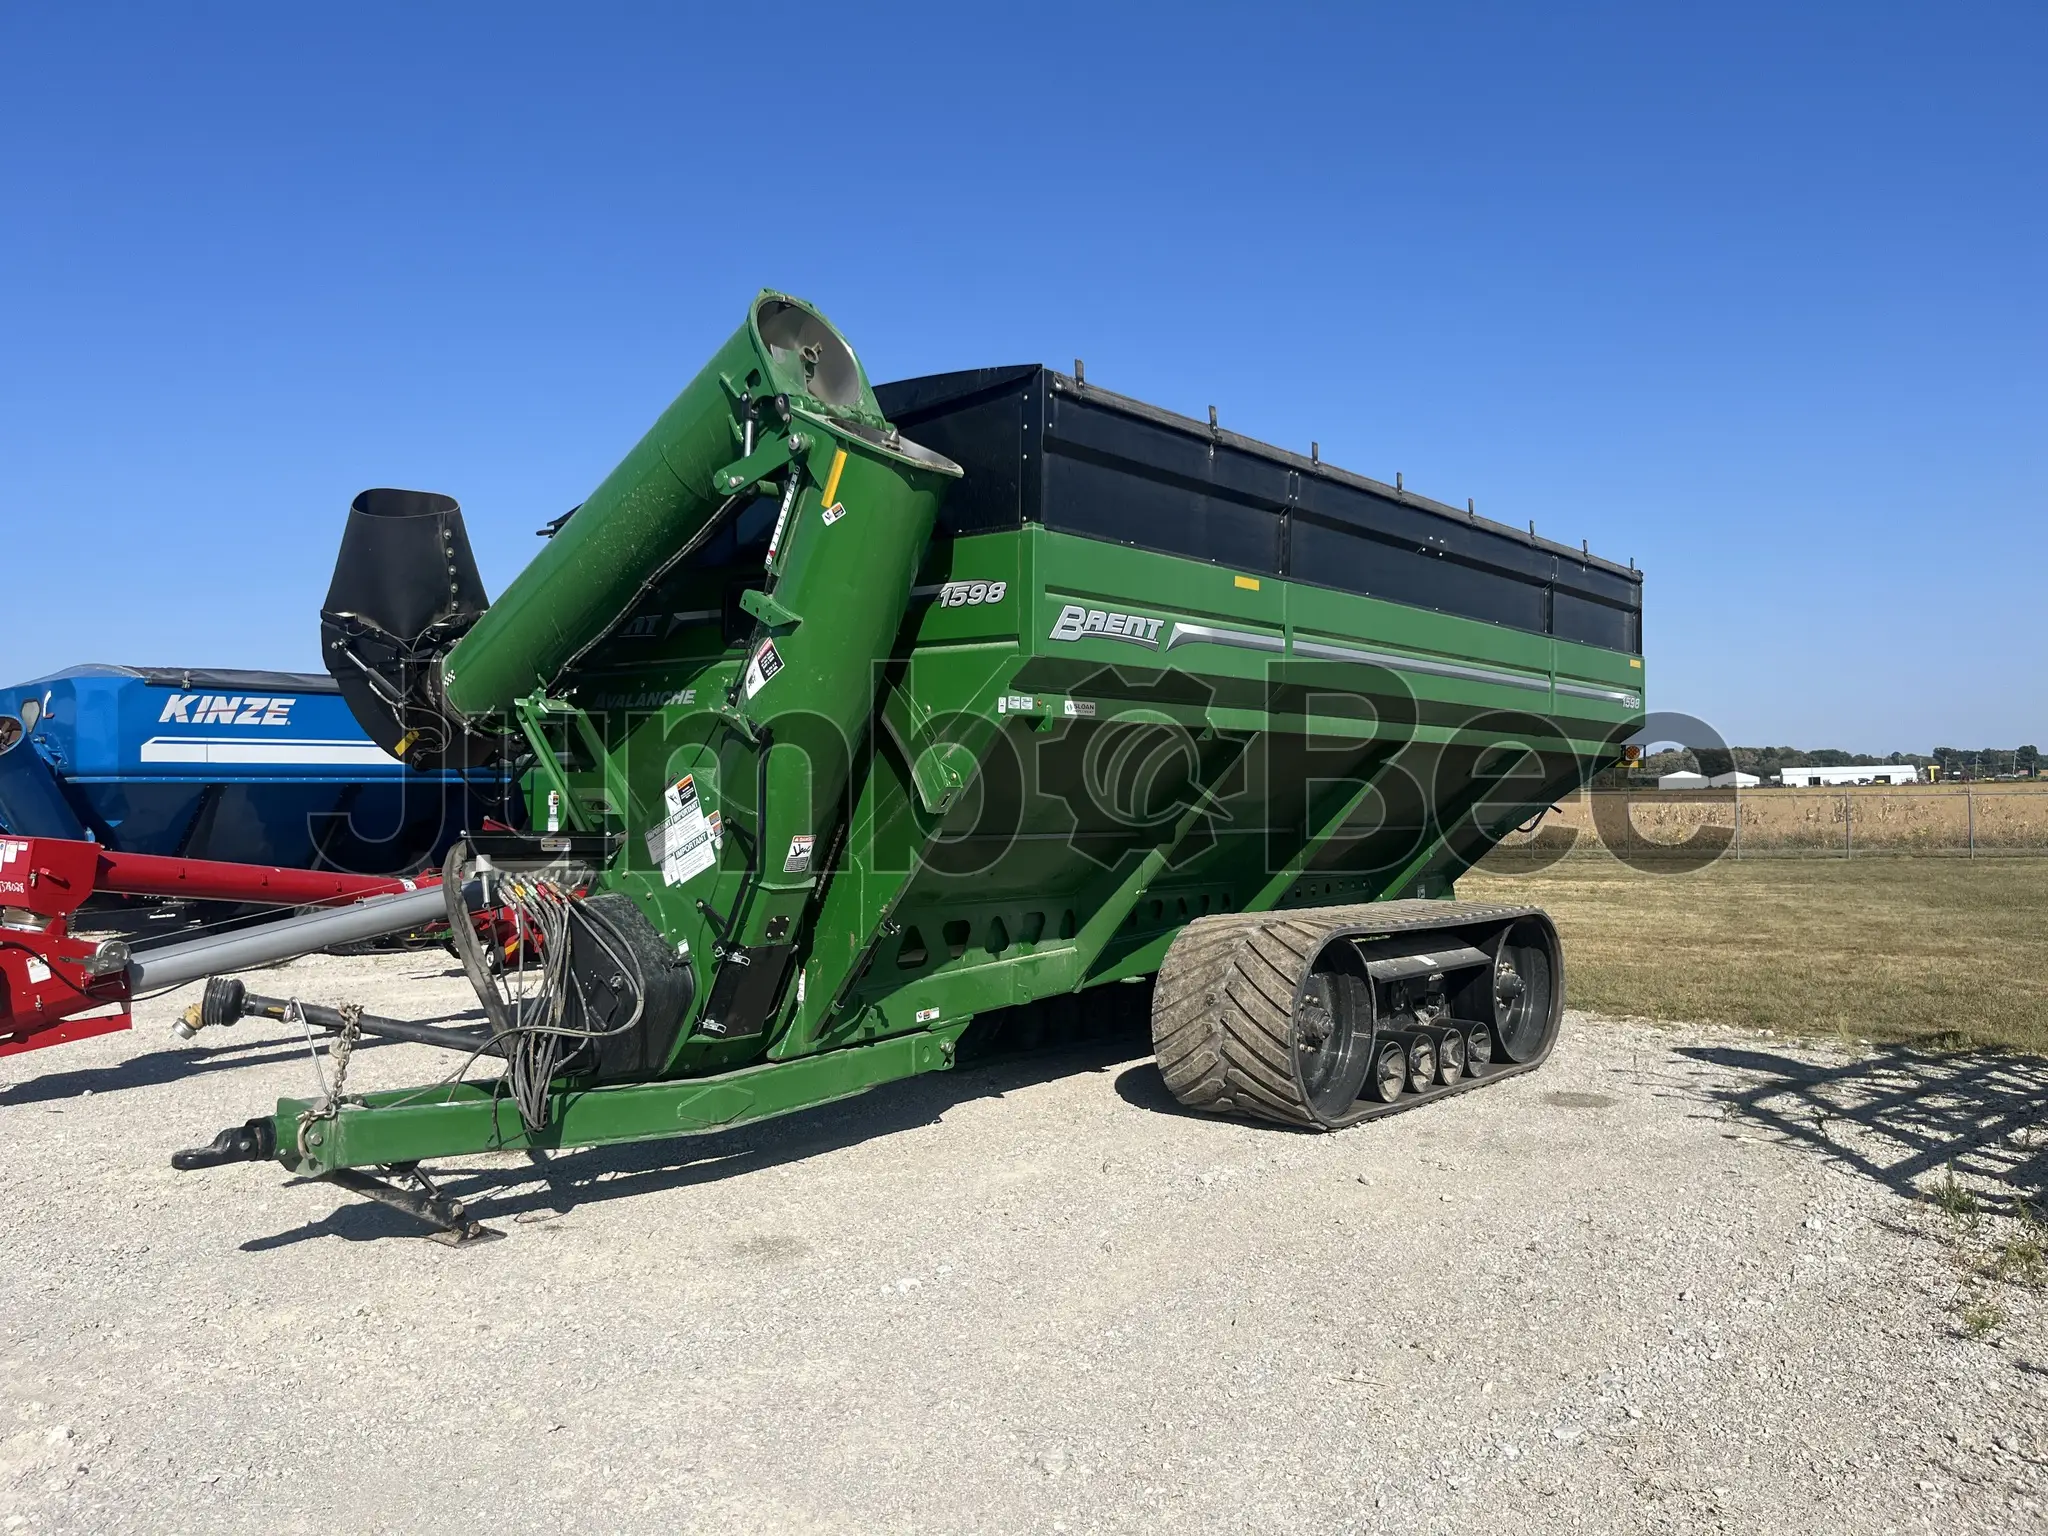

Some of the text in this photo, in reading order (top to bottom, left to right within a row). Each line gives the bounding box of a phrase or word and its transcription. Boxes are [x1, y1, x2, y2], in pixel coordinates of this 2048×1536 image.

[940, 581, 1007, 609] 1598
[158, 694, 297, 726] KINZE
[592, 689, 697, 709] AVALANCHE
[1073, 703, 1095, 711] SLOAN
[1622, 696, 1640, 709] 1598
[673, 800, 700, 823] IMPORTANT
[675, 832, 708, 859] IMPORTANT
